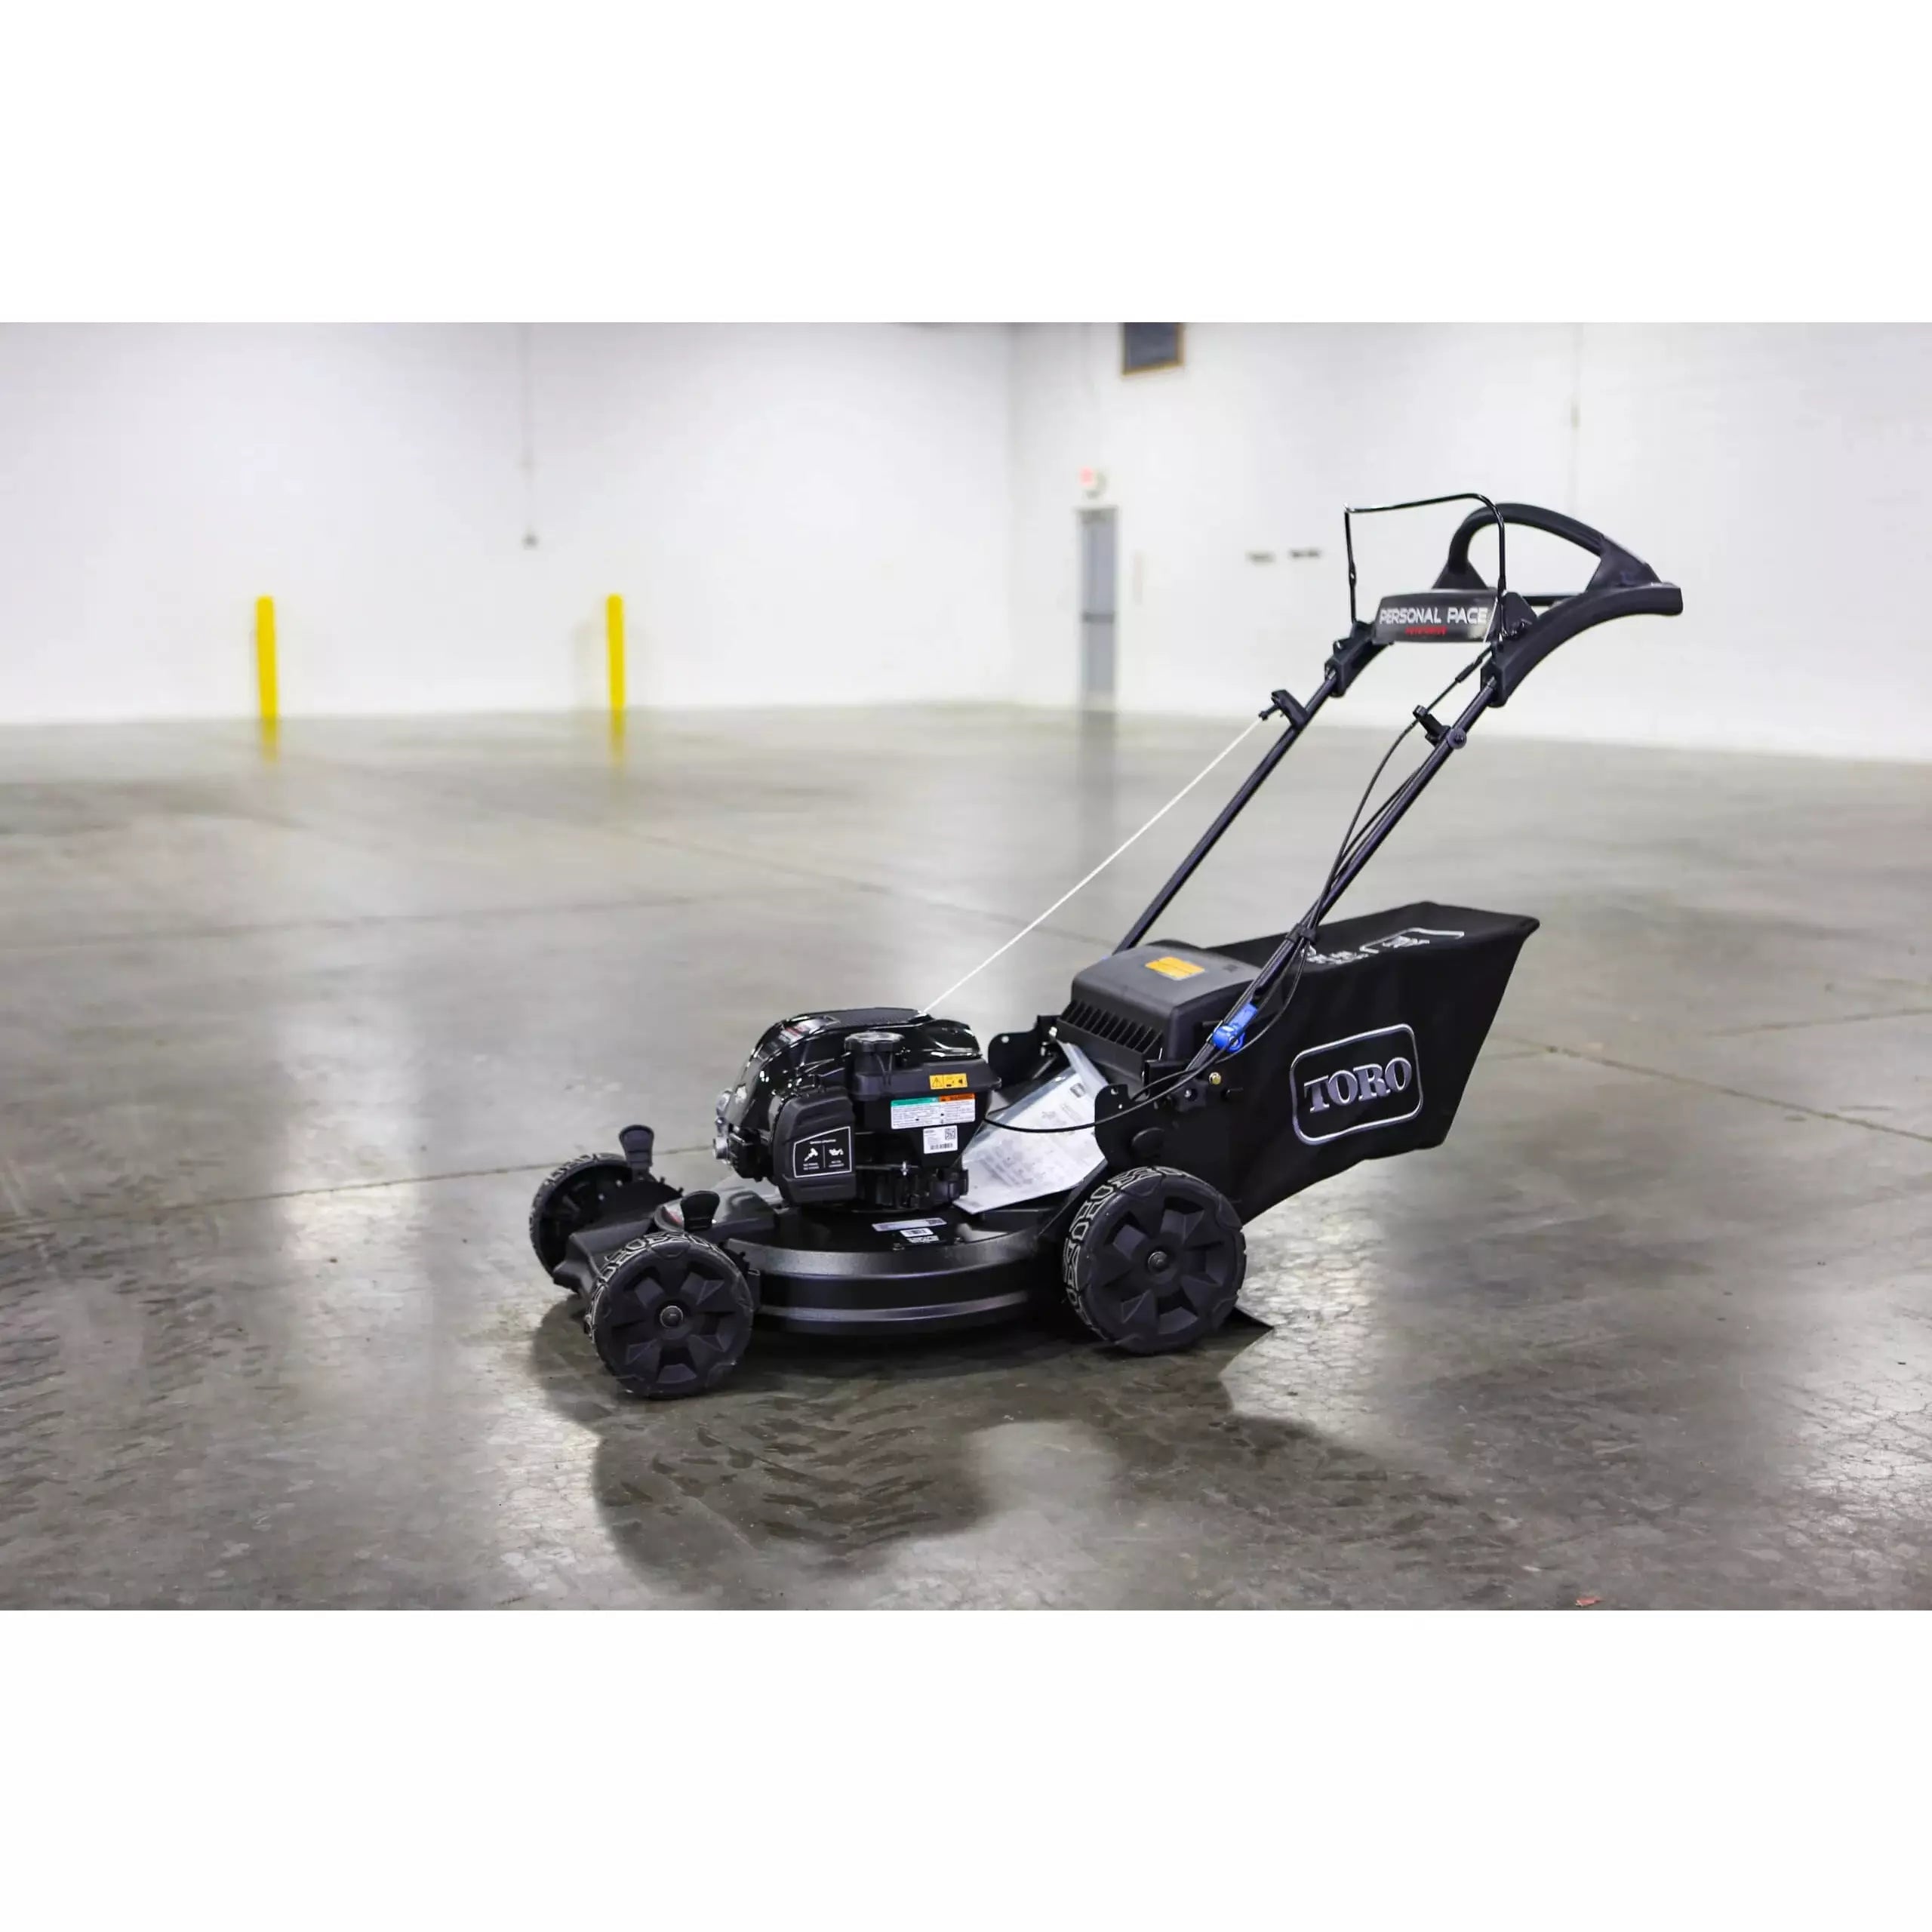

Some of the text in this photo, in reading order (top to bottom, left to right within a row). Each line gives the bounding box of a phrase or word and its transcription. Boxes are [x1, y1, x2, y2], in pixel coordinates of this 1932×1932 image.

[1379, 607, 1488, 624] PERSONAL PACE
[1303, 1057, 1412, 1113] TORO
